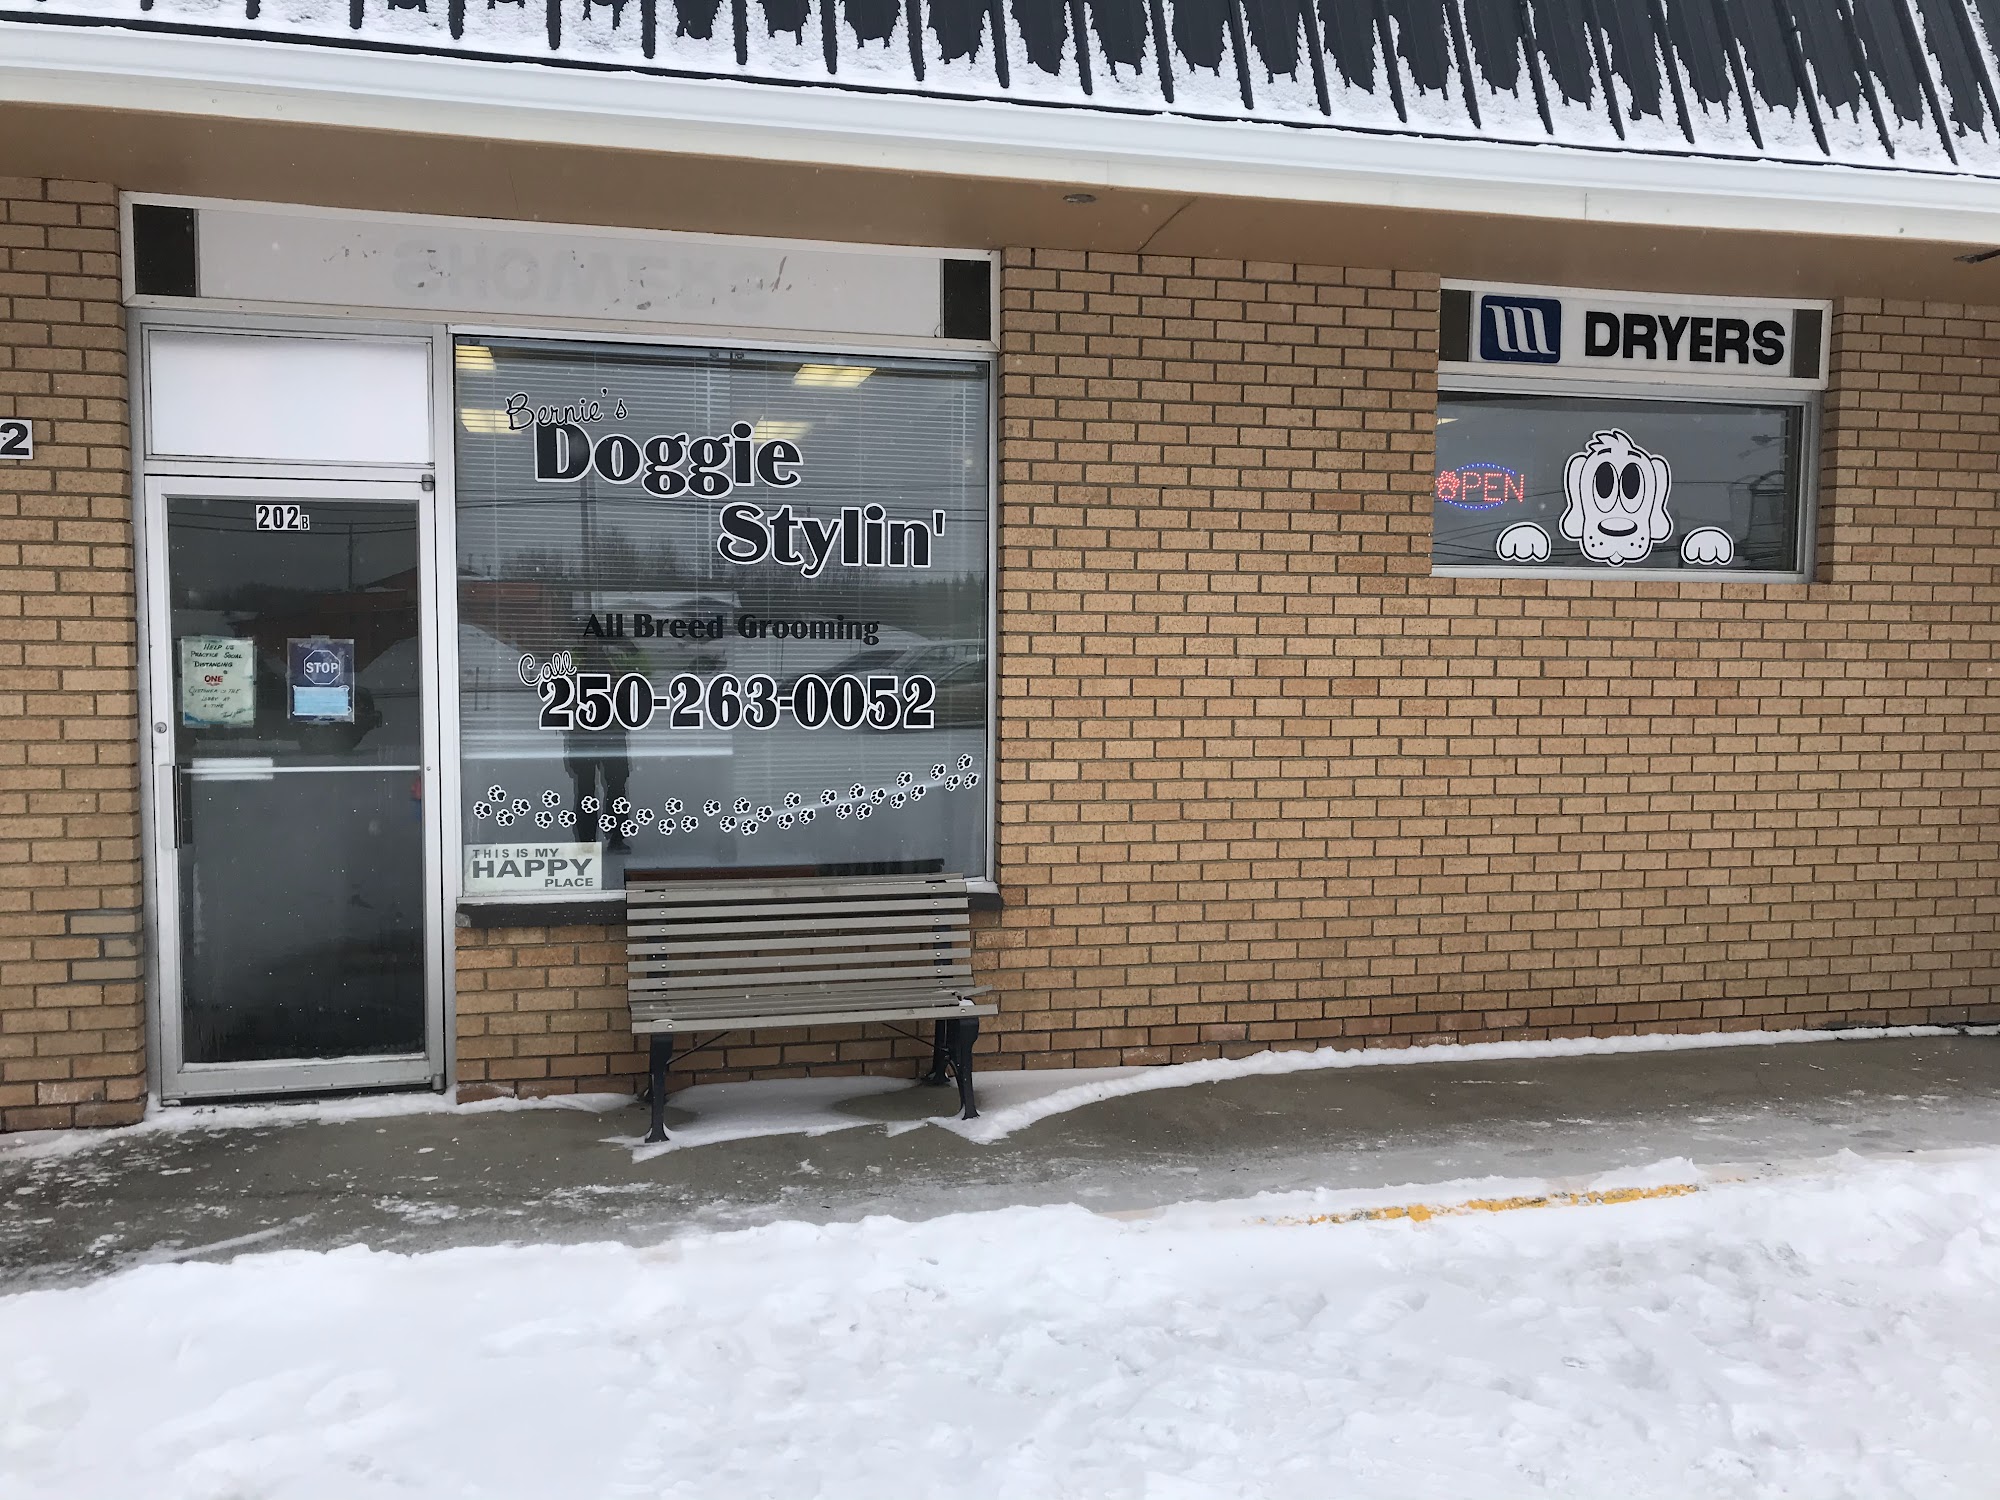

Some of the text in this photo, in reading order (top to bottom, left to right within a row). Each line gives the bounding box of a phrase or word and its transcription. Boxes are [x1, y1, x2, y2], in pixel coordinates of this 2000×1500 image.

[1583, 310, 1786, 366] DRYERS
[505, 387, 628, 431] Bernie's
[534, 421, 803, 498] Doggie
[717, 502, 946, 578] Stylin'
[583, 613, 880, 646] All Breed Grooming
[204, 675, 223, 683] ONE
[305, 662, 339, 674] STOP
[518, 651, 577, 687] Call
[538, 672, 936, 731] 250-263-0052
[472, 848, 560, 859] THIS IS MY
[472, 858, 593, 879] HAPPY
[544, 878, 594, 888] PLACE
